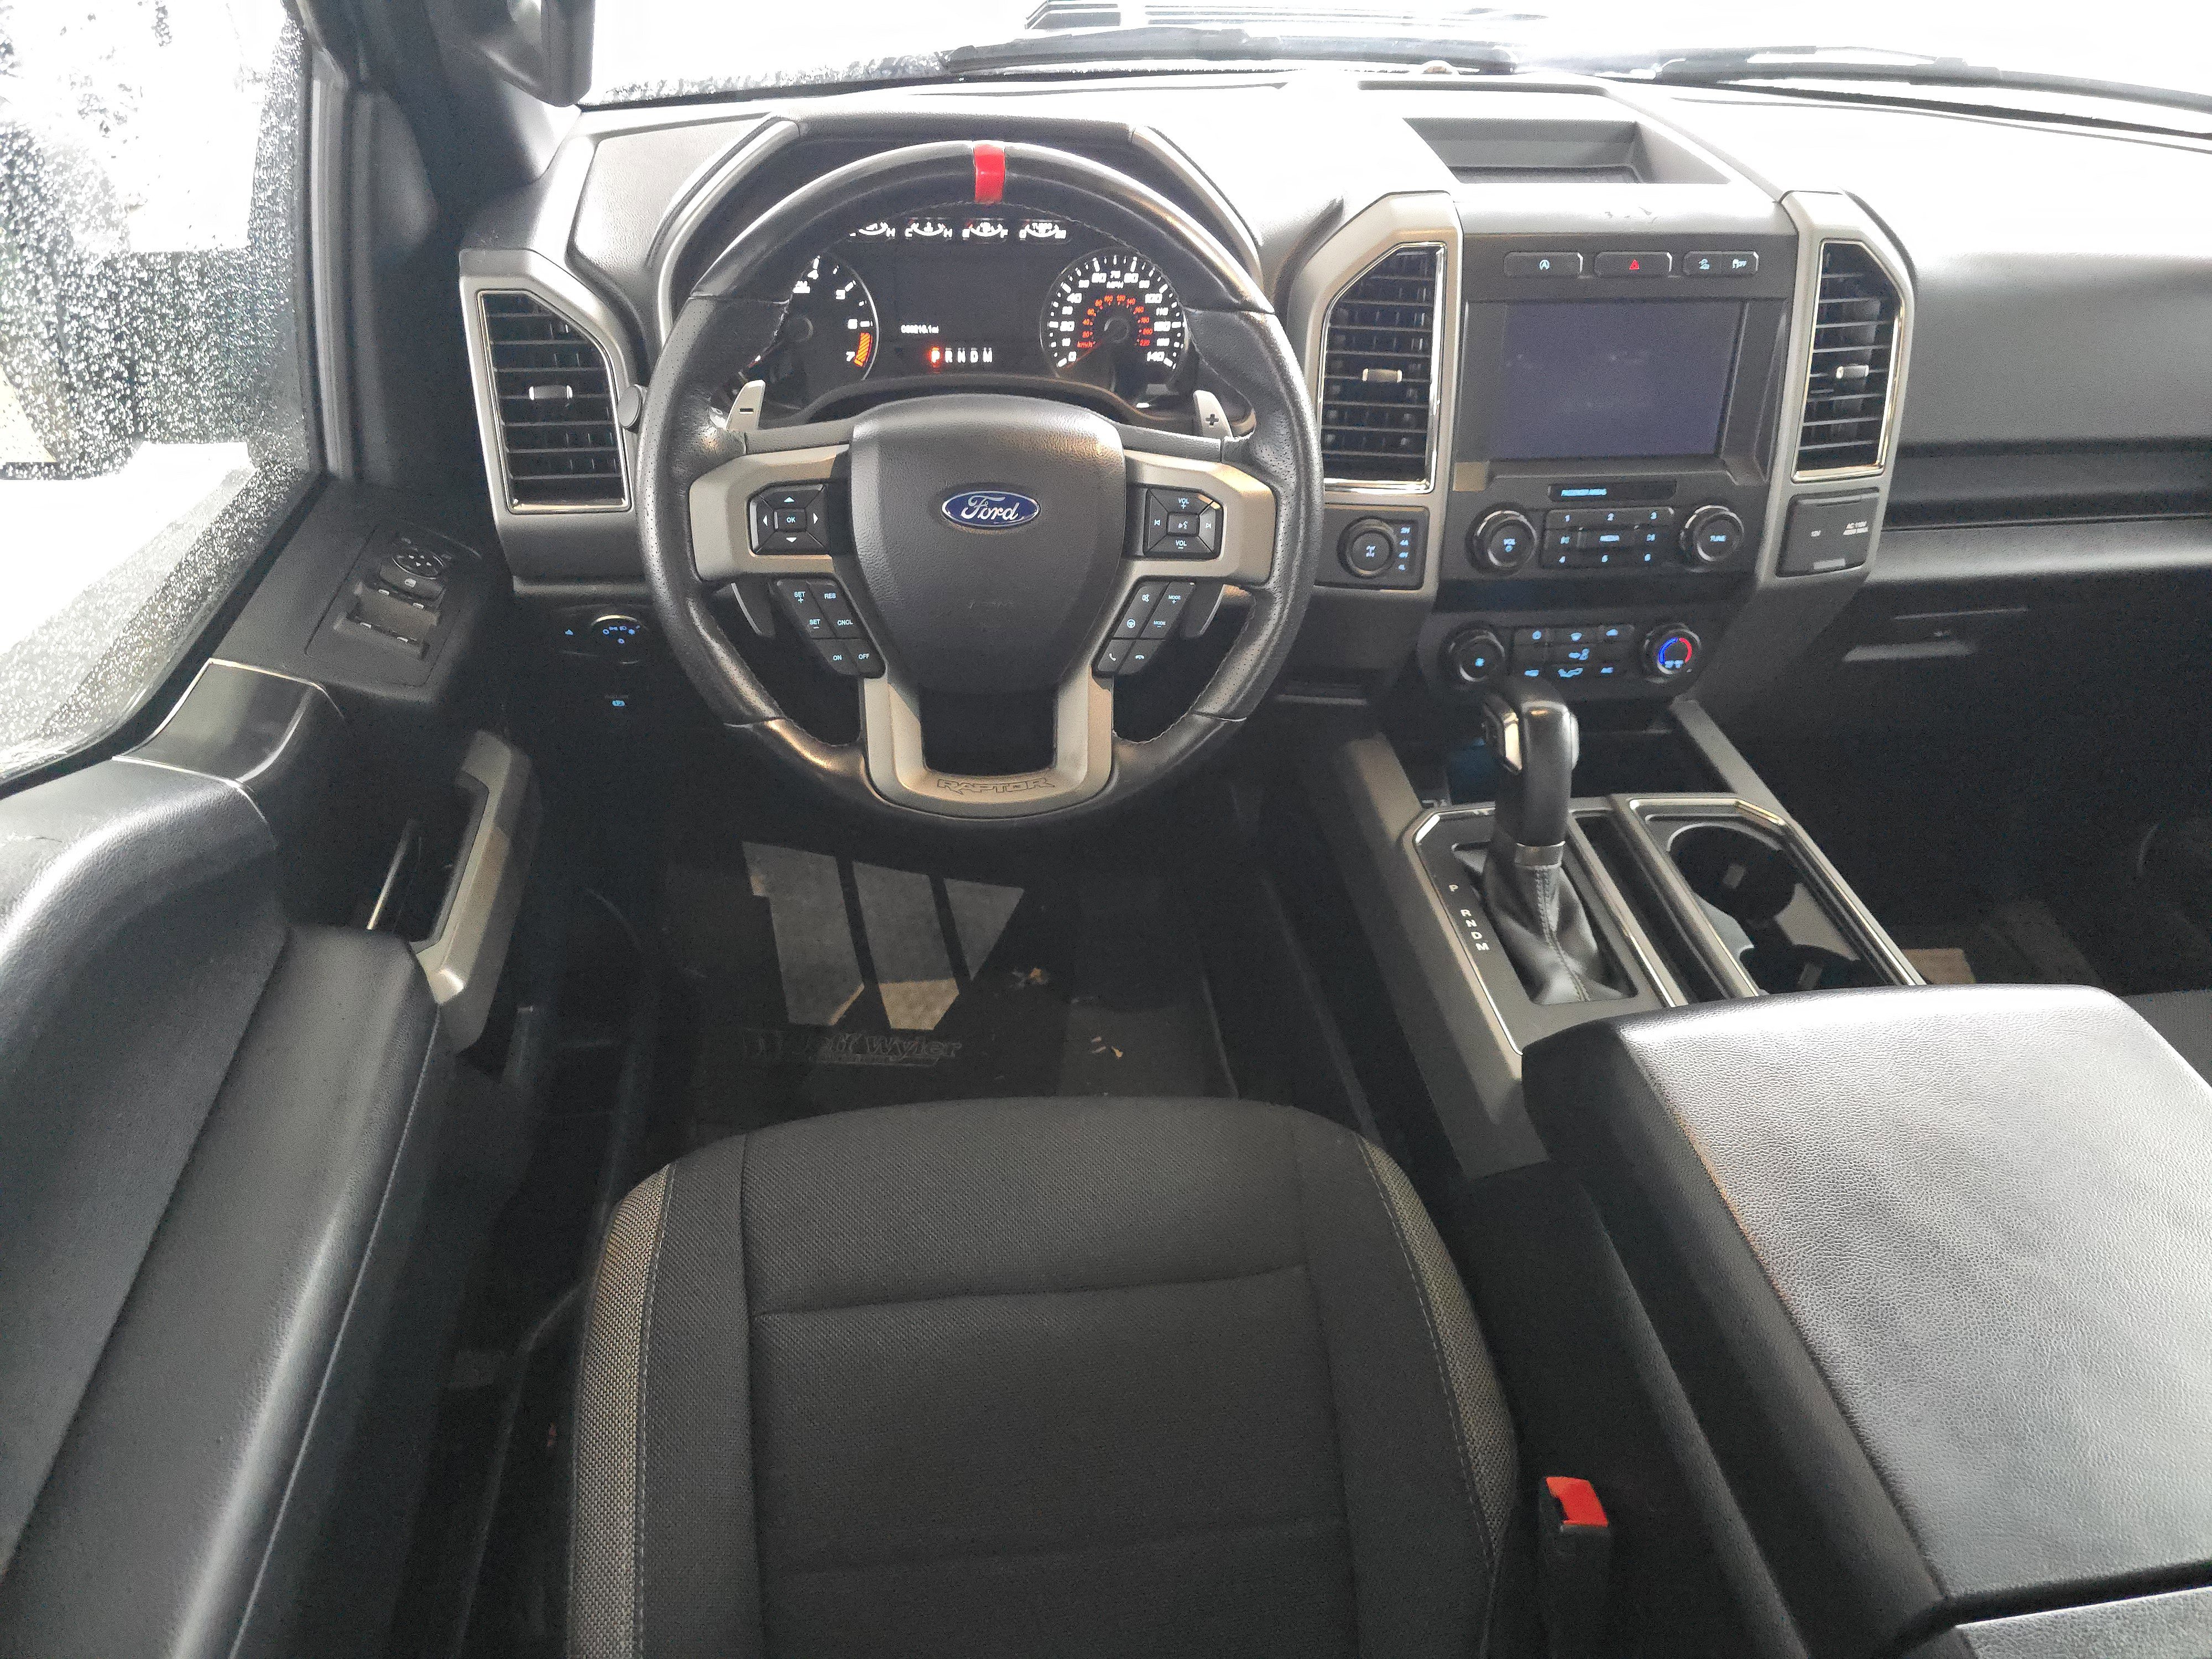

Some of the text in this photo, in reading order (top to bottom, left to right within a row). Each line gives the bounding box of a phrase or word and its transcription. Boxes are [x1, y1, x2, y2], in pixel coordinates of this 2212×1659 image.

[807, 270, 818, 279] 4
[1067, 293, 1082, 303] 40
[958, 350, 966, 363] N
[971, 350, 978, 363] D
[983, 350, 992, 363] M
[961, 495, 1020, 520] Ford
[936, 778, 1055, 795] RAPTOR
[1475, 942, 1490, 951] M
